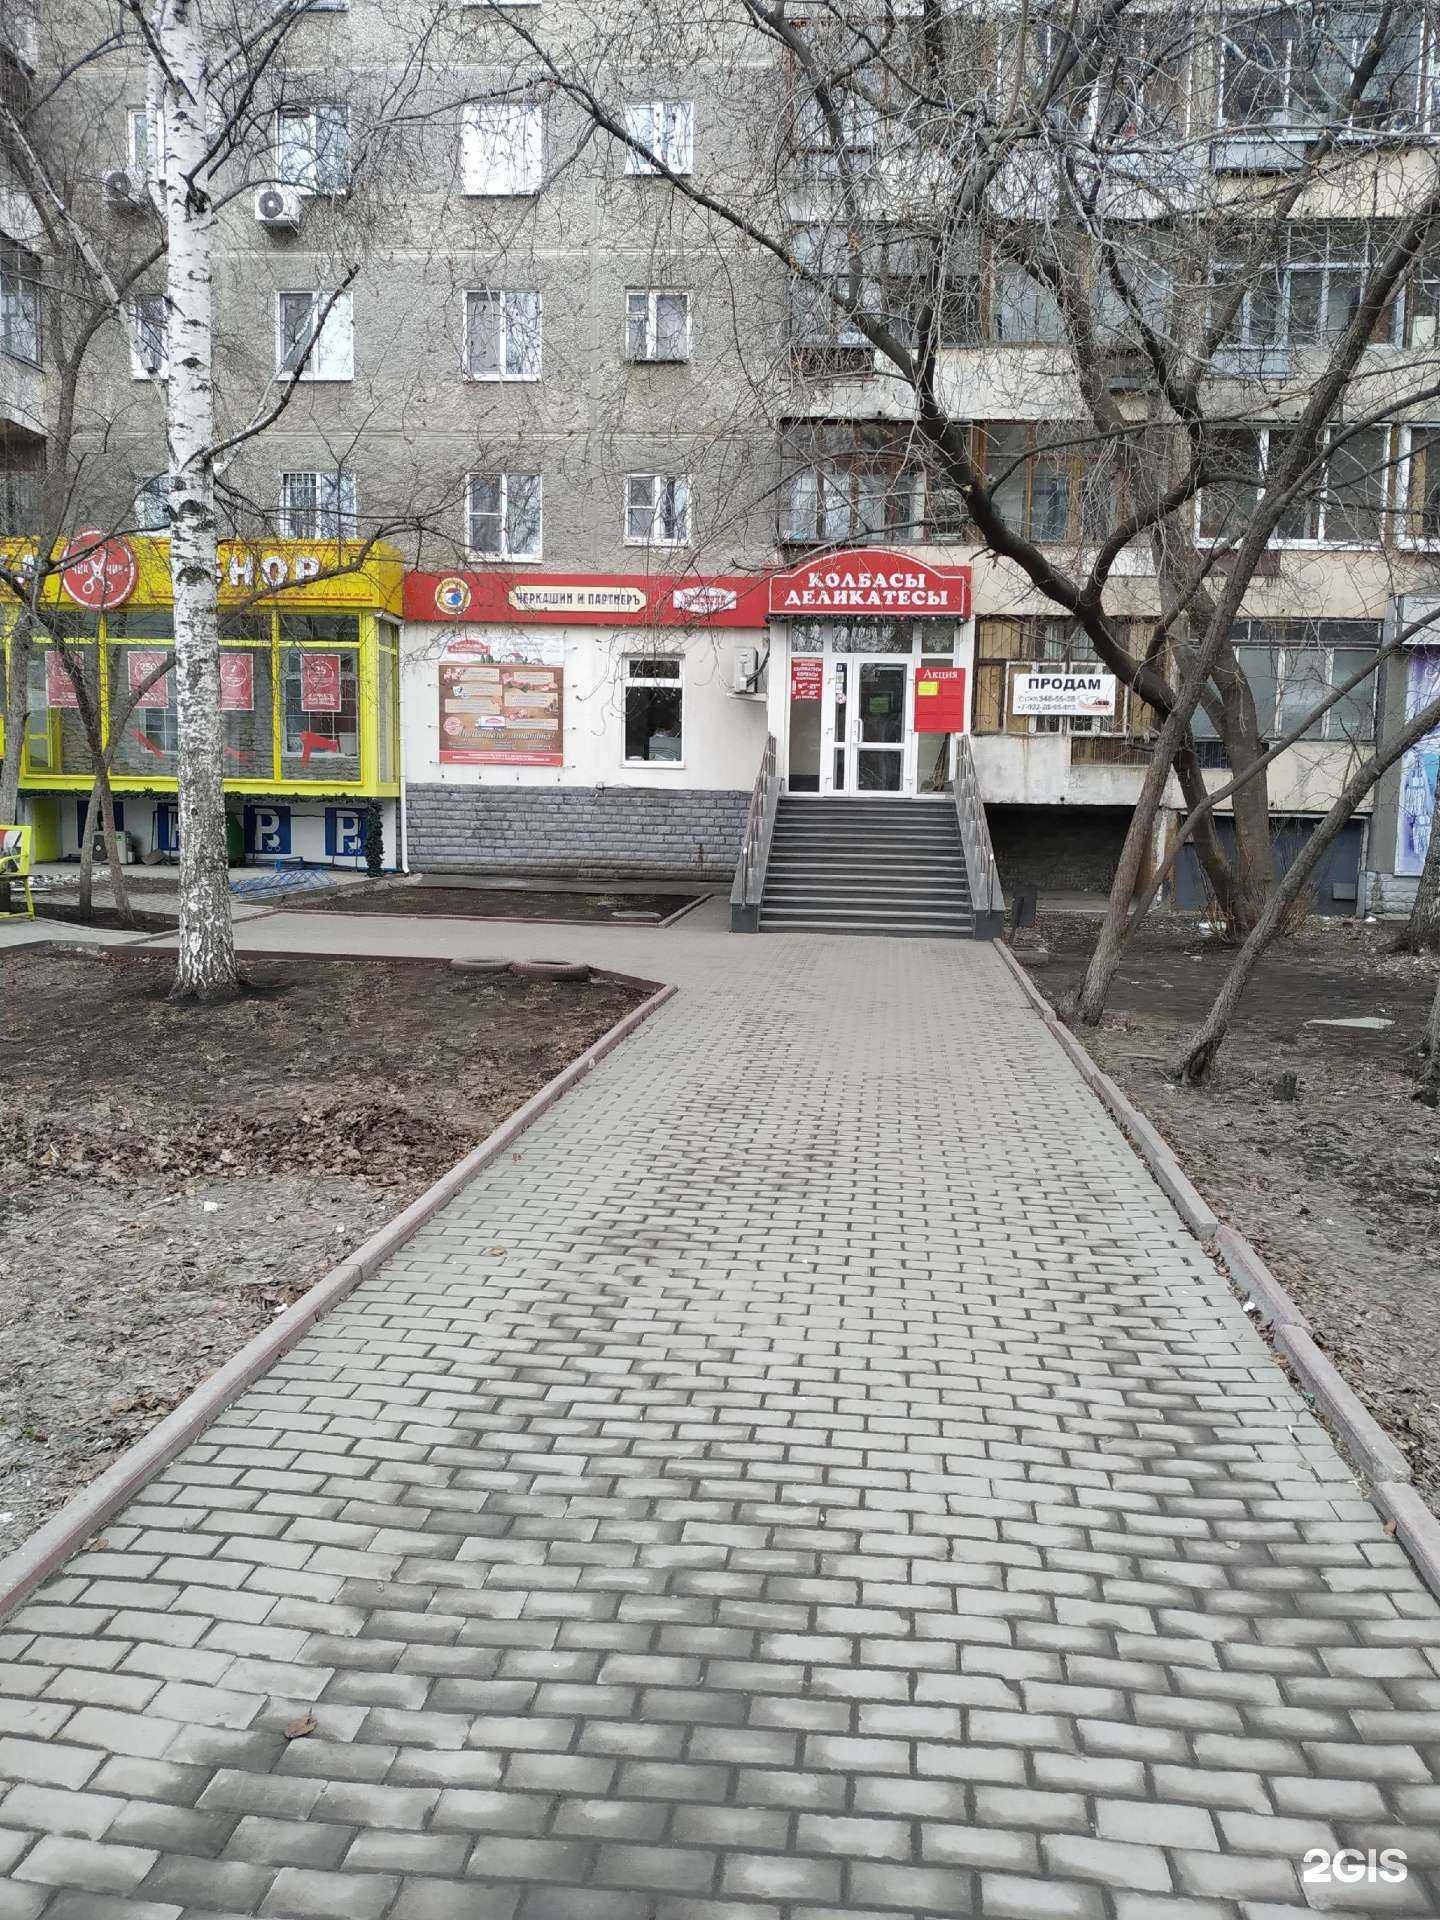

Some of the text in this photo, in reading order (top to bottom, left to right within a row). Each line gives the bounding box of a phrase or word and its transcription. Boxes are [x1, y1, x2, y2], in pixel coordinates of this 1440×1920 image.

[215, 555, 320, 588] HOP
[807, 572, 927, 588] КОЛБАСЫ
[516, 592, 640, 605] ЧЕРКАШИН И ПАРТНЕРЪ
[784, 589, 949, 606] ДЕЛИКАТЕСЫ
[1028, 678, 1101, 691] ПРОДАМ
